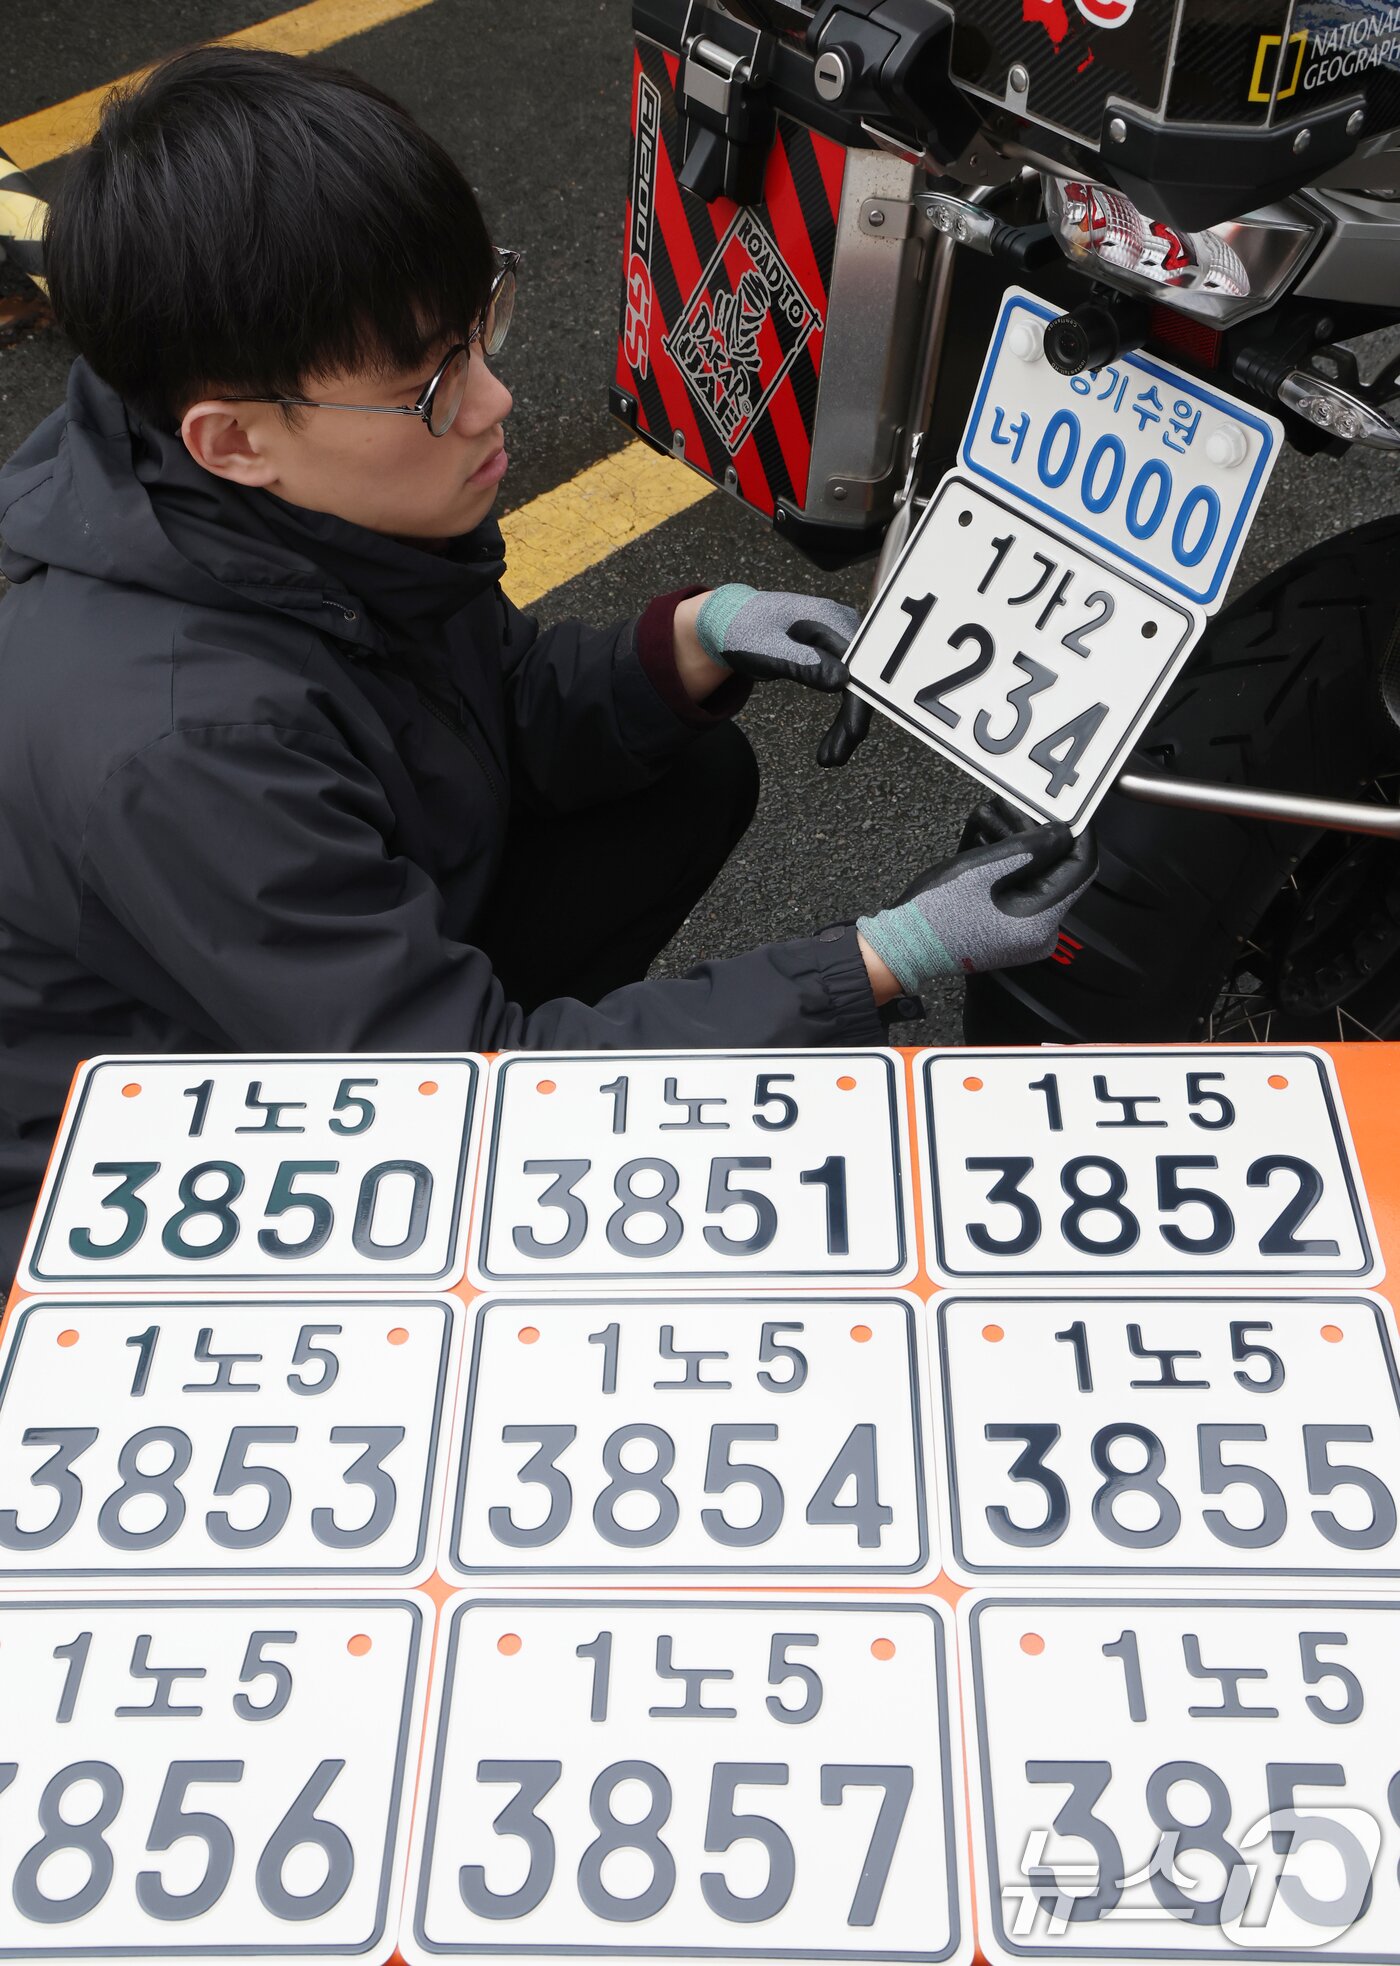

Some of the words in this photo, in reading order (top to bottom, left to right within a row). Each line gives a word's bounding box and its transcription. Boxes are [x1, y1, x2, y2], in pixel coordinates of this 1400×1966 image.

[1311, 7, 1400, 60] NATIONAL
[736, 216, 783, 292] ROAD
[777, 280, 806, 327] TO
[690, 303, 749, 415] DAKAR
[976, 534, 1118, 660] 1가2
[879, 592, 1110, 799] 1234
[69, 1160, 434, 1260] 3850
[512, 1155, 849, 1259] 3851
[965, 1155, 1340, 1257] 3852
[0, 1426, 405, 1551] 3853
[488, 1423, 893, 1548] 3854
[984, 1423, 1397, 1550] 3855
[0, 1759, 354, 1924] 856
[459, 1760, 914, 1927] 3857
[1025, 1760, 1400, 1928] 385
